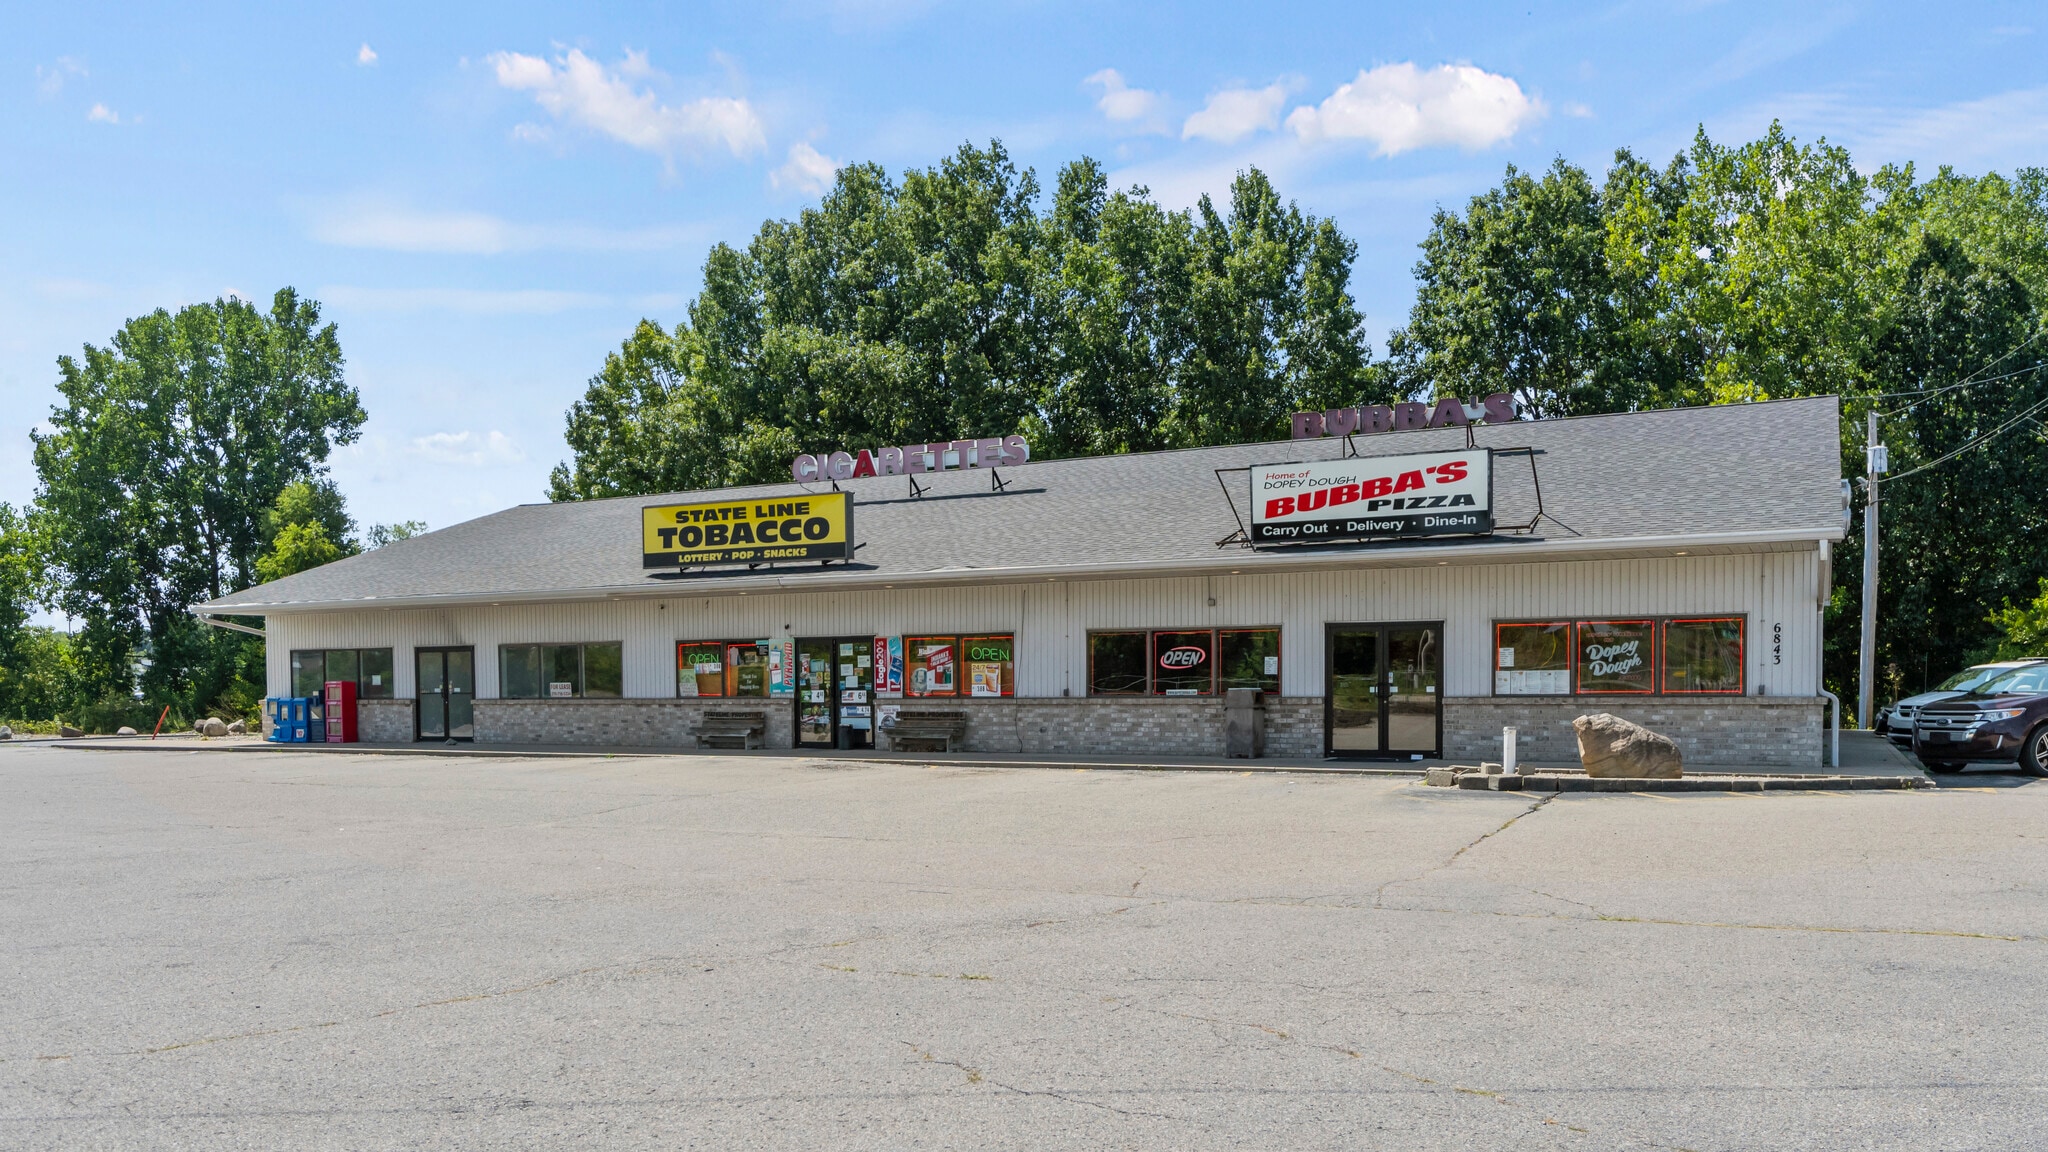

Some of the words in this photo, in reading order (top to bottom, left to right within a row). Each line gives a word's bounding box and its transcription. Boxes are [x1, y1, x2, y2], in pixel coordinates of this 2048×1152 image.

[1291, 393, 1515, 439] BUBBA'S
[792, 435, 1028, 483] CIGARETTES
[1263, 479, 1306, 490] DOPEY
[1308, 475, 1357, 487] DOUGH
[1265, 471, 1296, 481] Home
[1298, 470, 1311, 480] of
[1265, 460, 1468, 519] BUBBA'S
[675, 506, 747, 524] STATE
[755, 502, 810, 518] LINE
[1367, 493, 1476, 512] PIZZA
[657, 516, 830, 549] TOBACCO
[1262, 525, 1300, 537] Carry
[1302, 523, 1328, 534] Out
[1347, 519, 1405, 532] Delivery
[1424, 514, 1477, 527] Dine-In
[678, 552, 723, 563] LOTTERY
[732, 551, 755, 560] POP
[764, 547, 807, 558] SNACKS
[971, 646, 1010, 662] OPEN
[1586, 640, 1639, 662] Dopey
[1773, 622, 1781, 665] 6843
[688, 653, 719, 666] OPEN
[783, 641, 793, 687] PYRAMID
[876, 641, 886, 684] Eagle20's
[1163, 650, 1201, 666] OPEN
[1589, 653, 1642, 676] Dough
